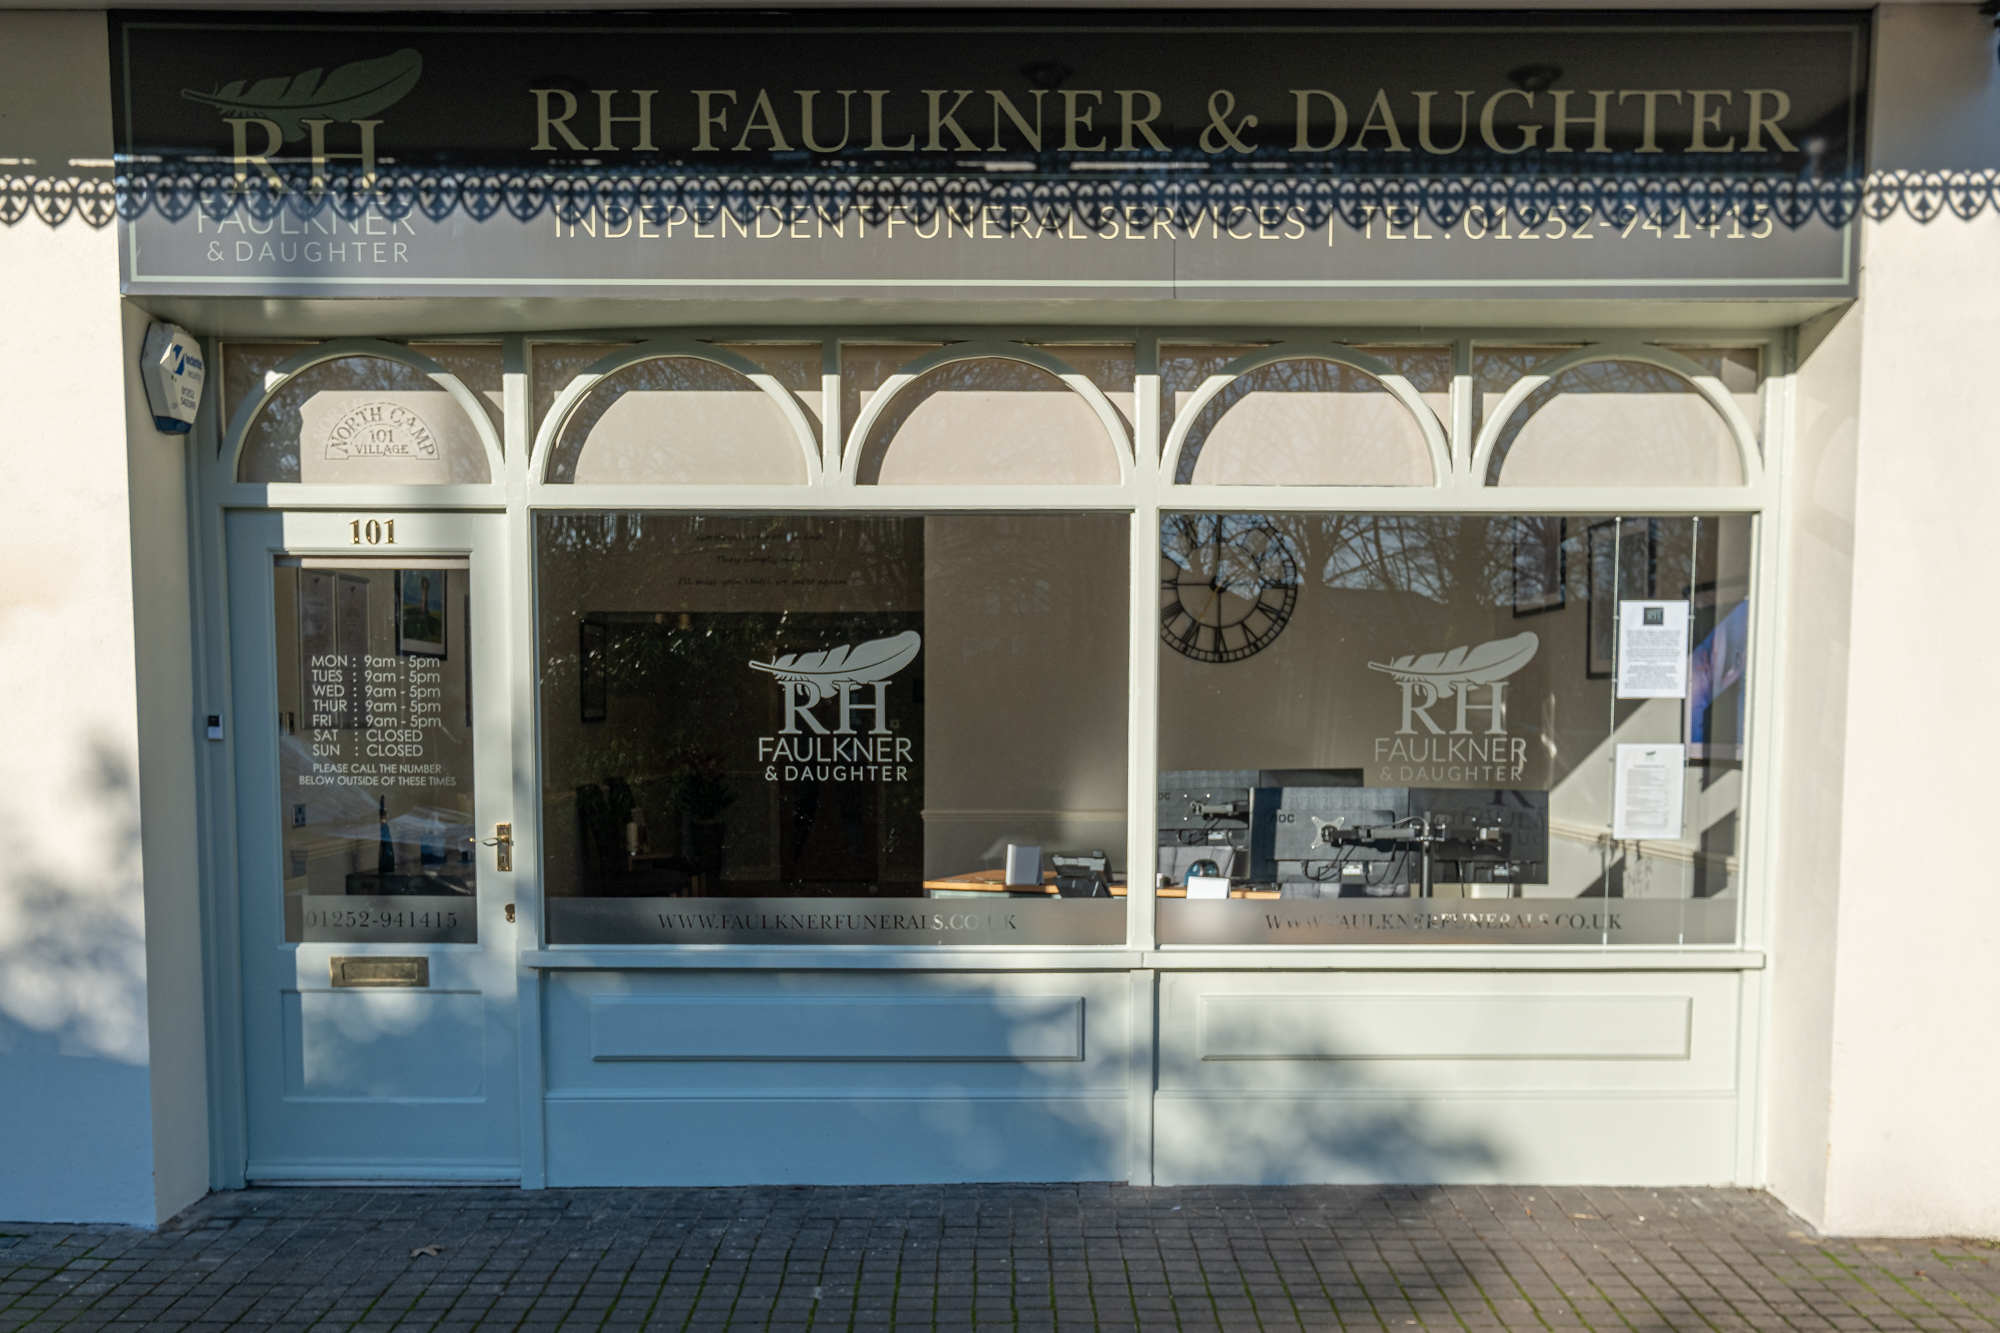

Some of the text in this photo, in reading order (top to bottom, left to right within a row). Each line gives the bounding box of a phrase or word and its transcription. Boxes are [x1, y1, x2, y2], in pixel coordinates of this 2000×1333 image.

[529, 88, 1800, 155] RH FAULKNER & DAUGHTER
[222, 117, 385, 196] RH
[197, 200, 416, 236] FAULKNER
[554, 204, 874, 240] INDEPENDENT
[888, 204, 1087, 240] FUNERAL
[1099, 204, 1307, 241] SERVICES
[1463, 203, 1774, 241] 01252-941415
[206, 240, 409, 264] & DAUGHTER
[330, 406, 436, 456] NORTH CAMP
[355, 444, 410, 457] VILLAGE
[349, 518, 398, 545] 101
[311, 655, 348, 668] MON
[364, 655, 396, 668] 9am
[408, 655, 440, 670] 5pm
[312, 670, 343, 683] TUES
[364, 670, 397, 683] 9am
[408, 670, 441, 685] 5pm
[312, 684, 345, 697] WED
[364, 684, 397, 698] 9am
[409, 685, 441, 700] 5pm
[313, 699, 348, 712] THUR
[365, 699, 397, 713] 9am
[409, 700, 441, 715] 5pm
[778, 679, 893, 735] RH
[1394, 680, 1510, 735] RH
[313, 714, 332, 727] FRI
[366, 715, 398, 727] 9am
[410, 715, 442, 729] 5pm
[313, 729, 339, 742] SAT
[366, 729, 423, 742] CLOSED
[312, 744, 340, 757] SUN
[366, 744, 423, 757] CLOSED
[758, 736, 914, 763] FAULKNER
[1374, 737, 1528, 763] FAULKNER
[313, 763, 442, 774] PLEASE CALL THE NUMBER
[764, 765, 908, 782] & DAUGHTER
[1379, 765, 1523, 782] & DAUGHTER
[299, 775, 457, 787] BELOW OUTSIDE OF THESE TIMES
[305, 910, 458, 929] 01252-941415
[658, 913, 1018, 931] WWW.FAULKNERFUNERALS.COUK
[1265, 912, 1623, 931] WWWAULKNERFUNERALSCO.UK
